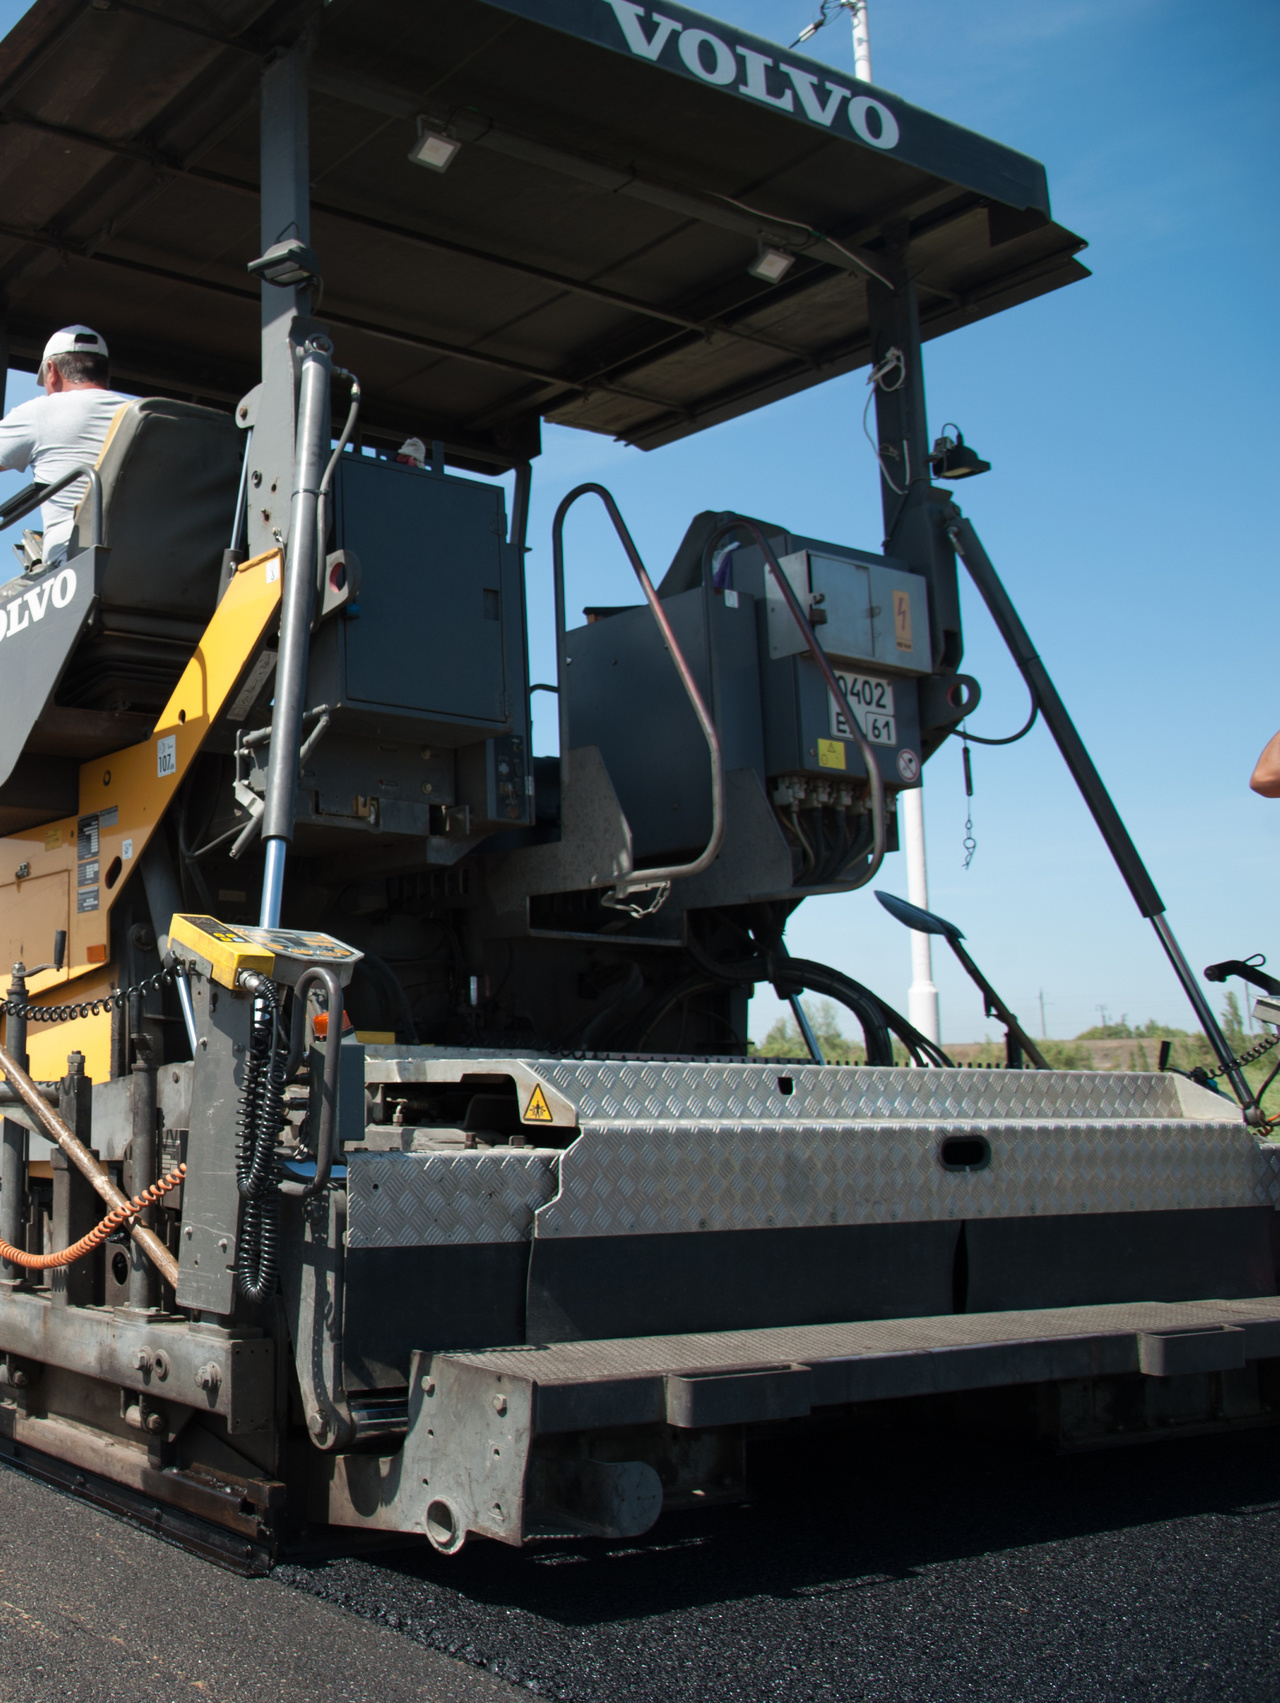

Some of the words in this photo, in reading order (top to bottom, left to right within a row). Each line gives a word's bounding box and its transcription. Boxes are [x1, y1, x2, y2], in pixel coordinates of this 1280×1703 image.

[601, 0, 900, 150] VOLVO
[872, 718, 891, 741] 61
[158, 753, 171, 774] 107
